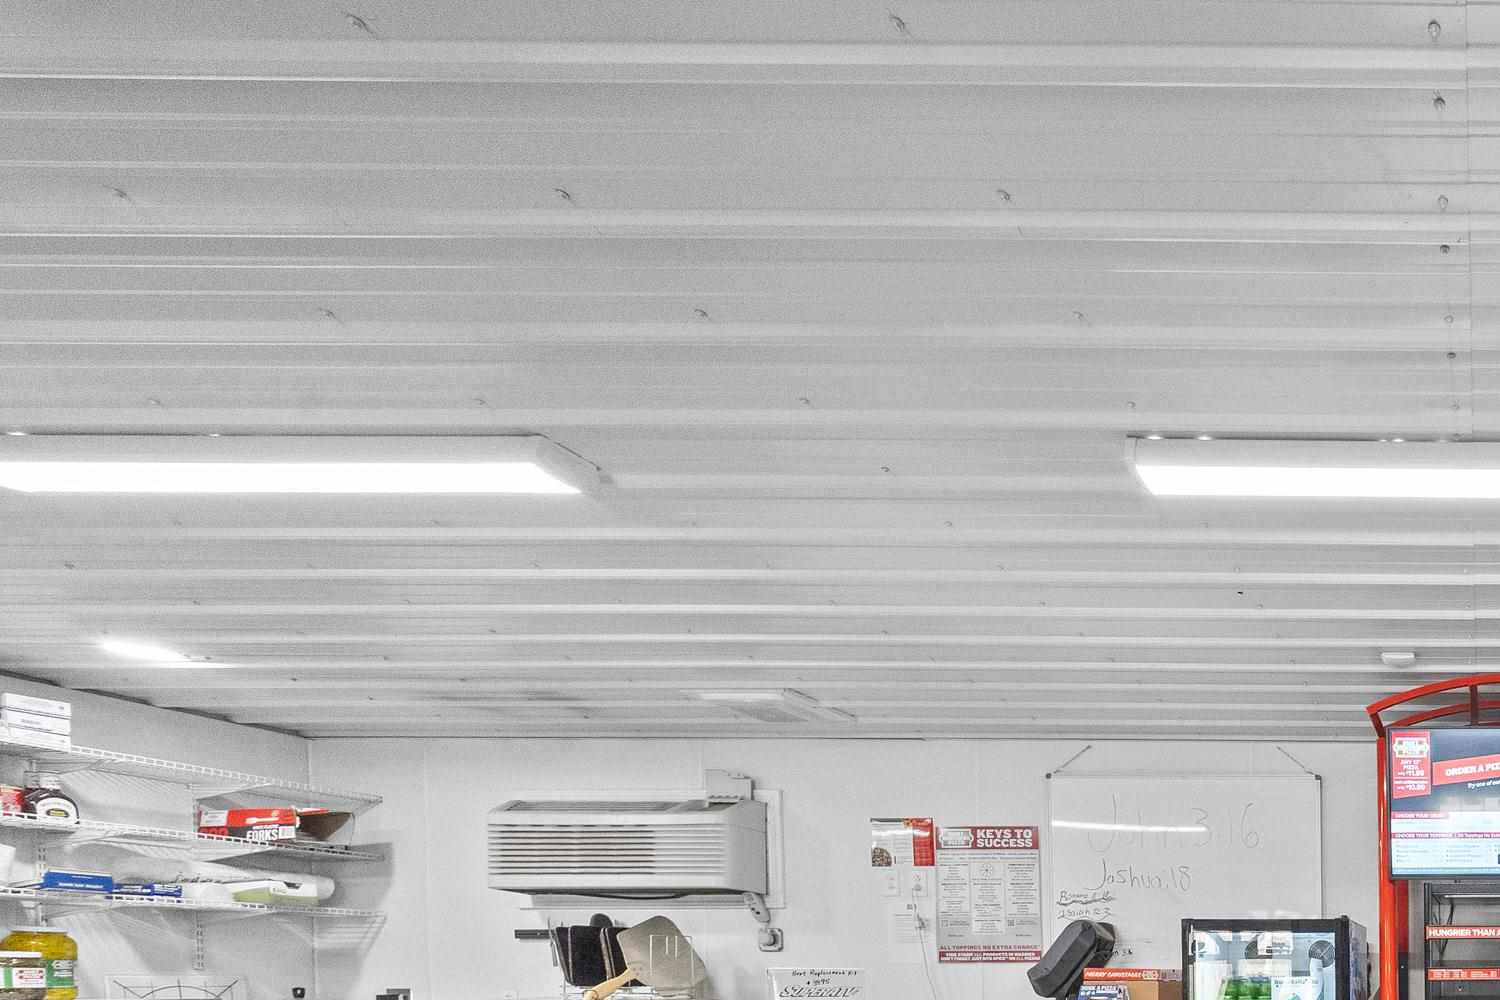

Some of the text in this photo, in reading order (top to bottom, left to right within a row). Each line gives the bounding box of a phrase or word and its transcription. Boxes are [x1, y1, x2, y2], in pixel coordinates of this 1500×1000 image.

[977, 829, 1014, 839] KEYS
[1016, 829, 1033, 839] TO
[976, 838, 1033, 848] SUCCESS
[1472, 929, 1496, 937] THAN
